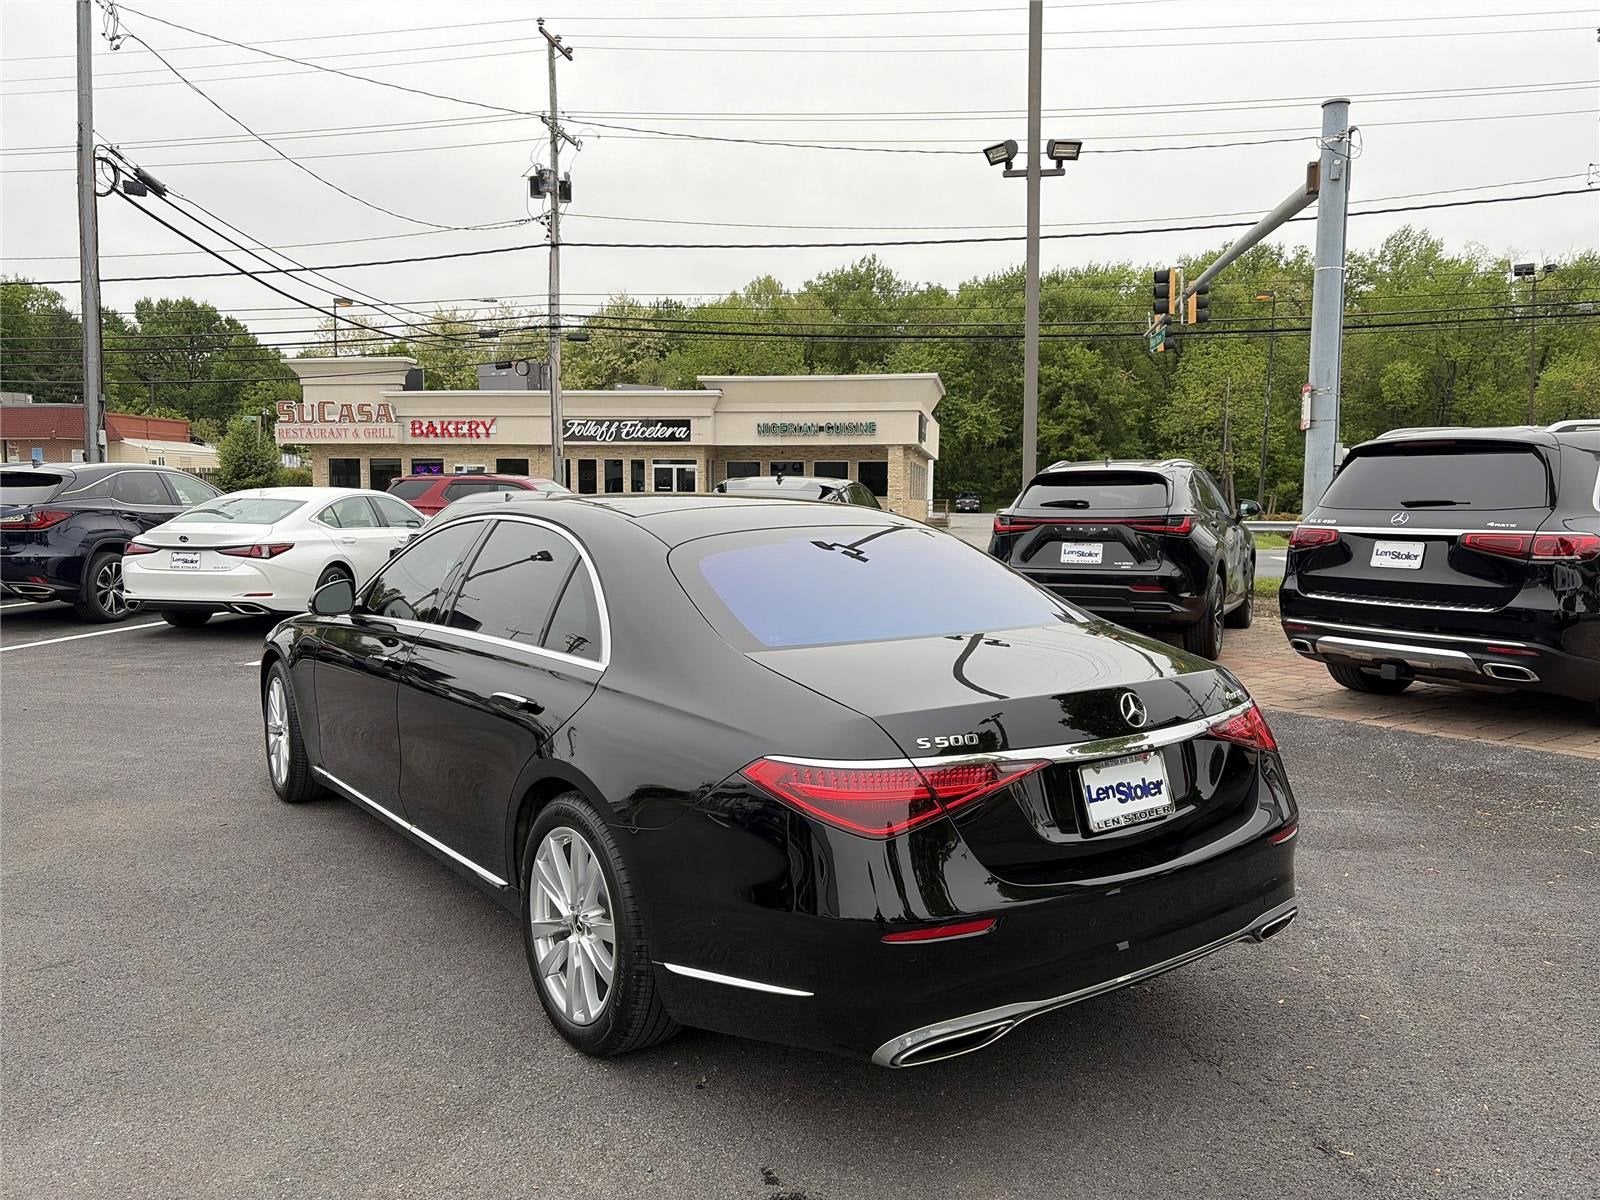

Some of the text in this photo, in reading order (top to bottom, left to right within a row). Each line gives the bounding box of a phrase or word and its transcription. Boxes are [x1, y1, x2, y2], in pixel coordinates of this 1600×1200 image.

[278, 427, 395, 440] RESTAURANT & GRILL
[410, 417, 497, 439] BAKERY
[620, 420, 690, 440] Etcetera
[757, 421, 877, 437] NIGERIAN CUISINE
[916, 733, 979, 749] S 500
[1096, 805, 1172, 830] LEN STOLER
